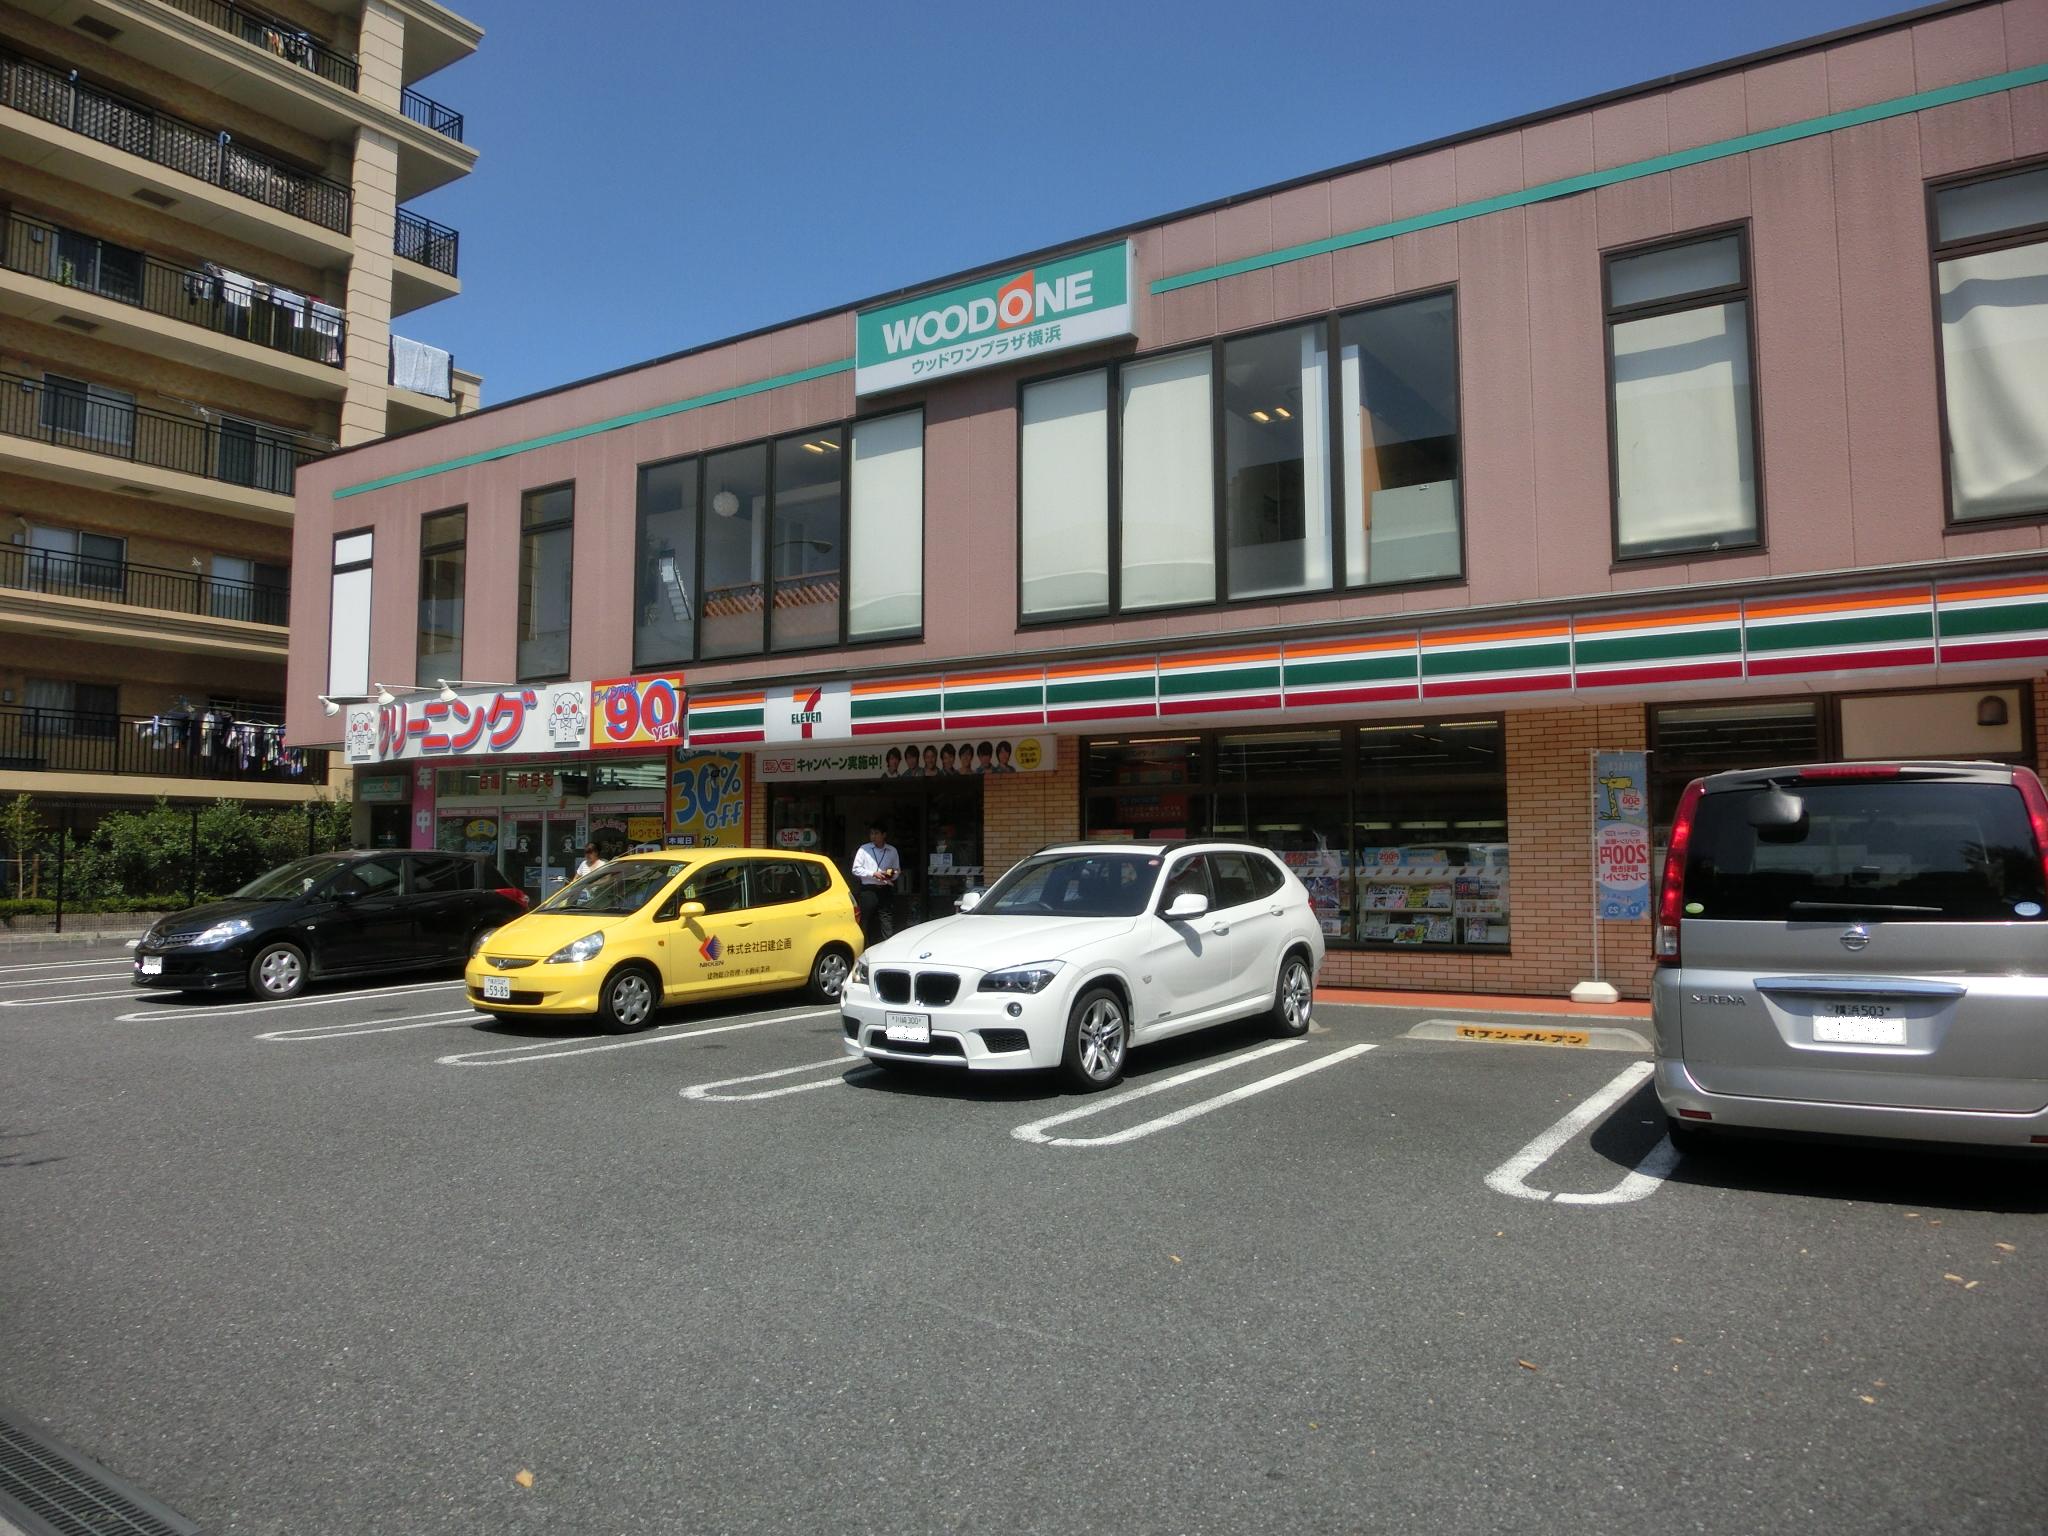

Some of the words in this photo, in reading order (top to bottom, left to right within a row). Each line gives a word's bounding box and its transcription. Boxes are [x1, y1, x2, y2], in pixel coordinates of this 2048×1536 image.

[882, 270, 1093, 355] WOODONE
[912, 324, 1062, 375] ウッドワンプラザ横浜
[378, 689, 539, 759] クリーニング
[604, 678, 680, 742] 90
[652, 721, 679, 742] YEN
[792, 687, 822, 739] 7
[781, 831, 800, 842] たばこ
[726, 937, 792, 956] 株式会社日建企画
[1691, 993, 1746, 1006] SERENA
